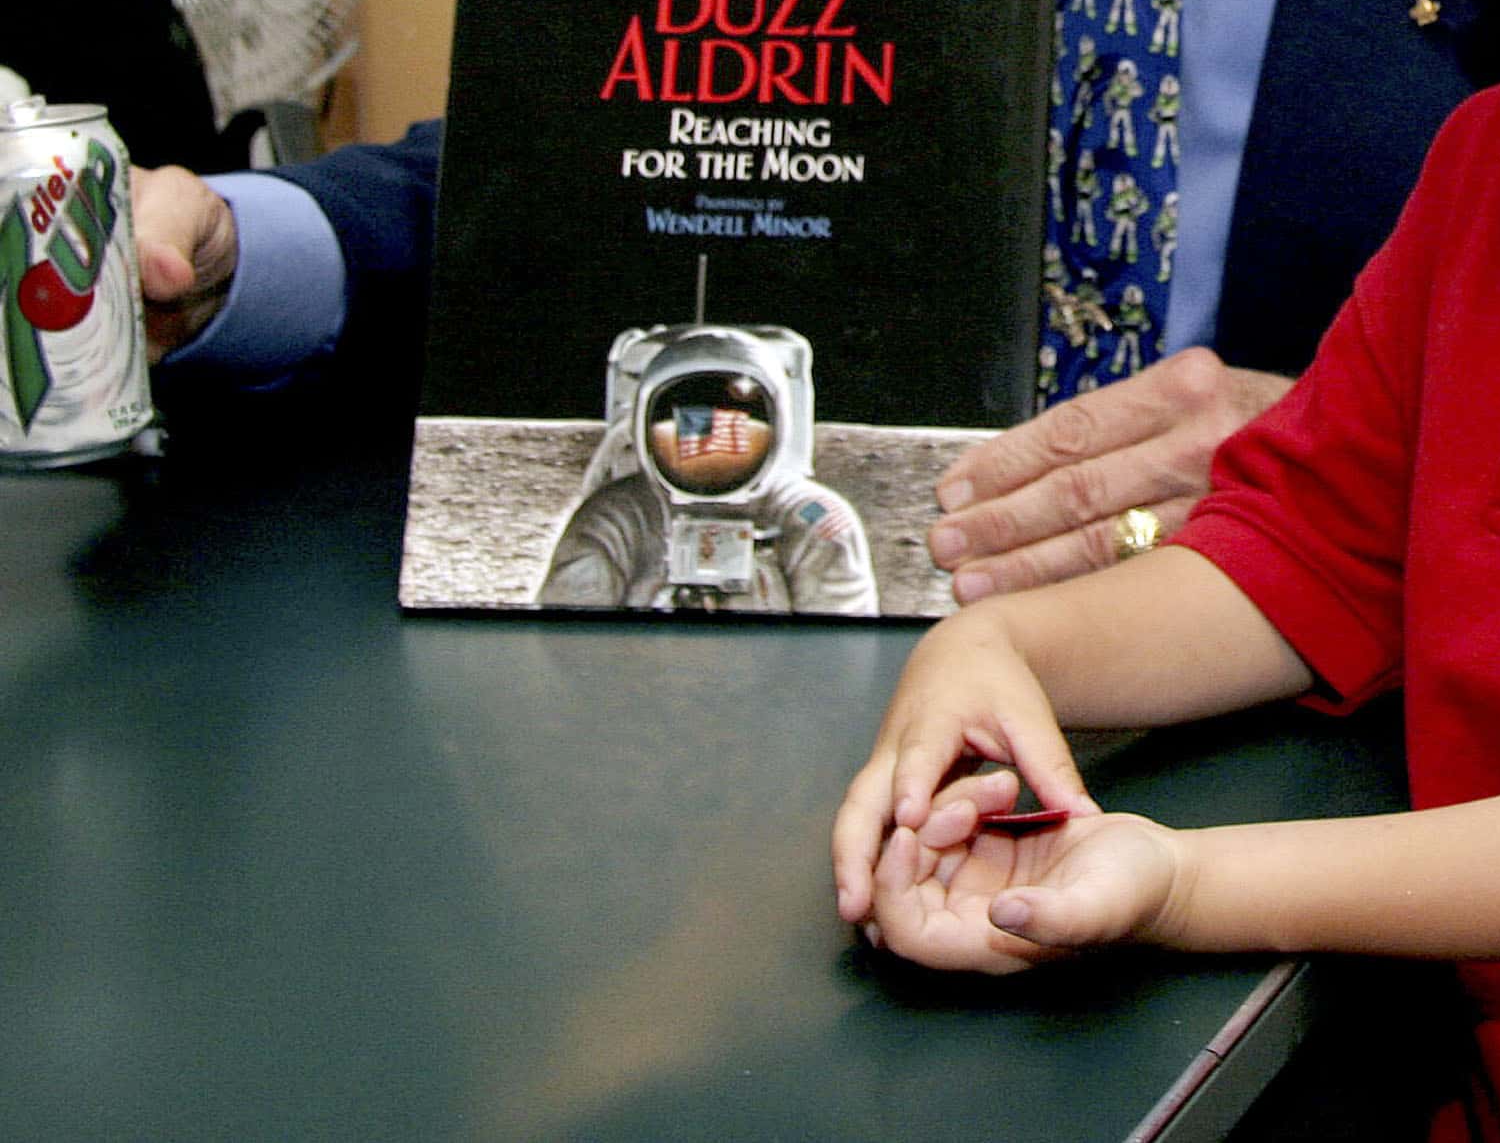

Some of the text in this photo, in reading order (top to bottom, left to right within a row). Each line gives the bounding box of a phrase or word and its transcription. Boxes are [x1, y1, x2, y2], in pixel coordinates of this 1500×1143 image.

[599, 14, 896, 106] ALDRIN
[669, 107, 833, 148] REACHING
[620, 147, 866, 184] FOR THE MOON
[30, 154, 74, 235] diet
[644, 206, 833, 240] WENDELL MINOR
